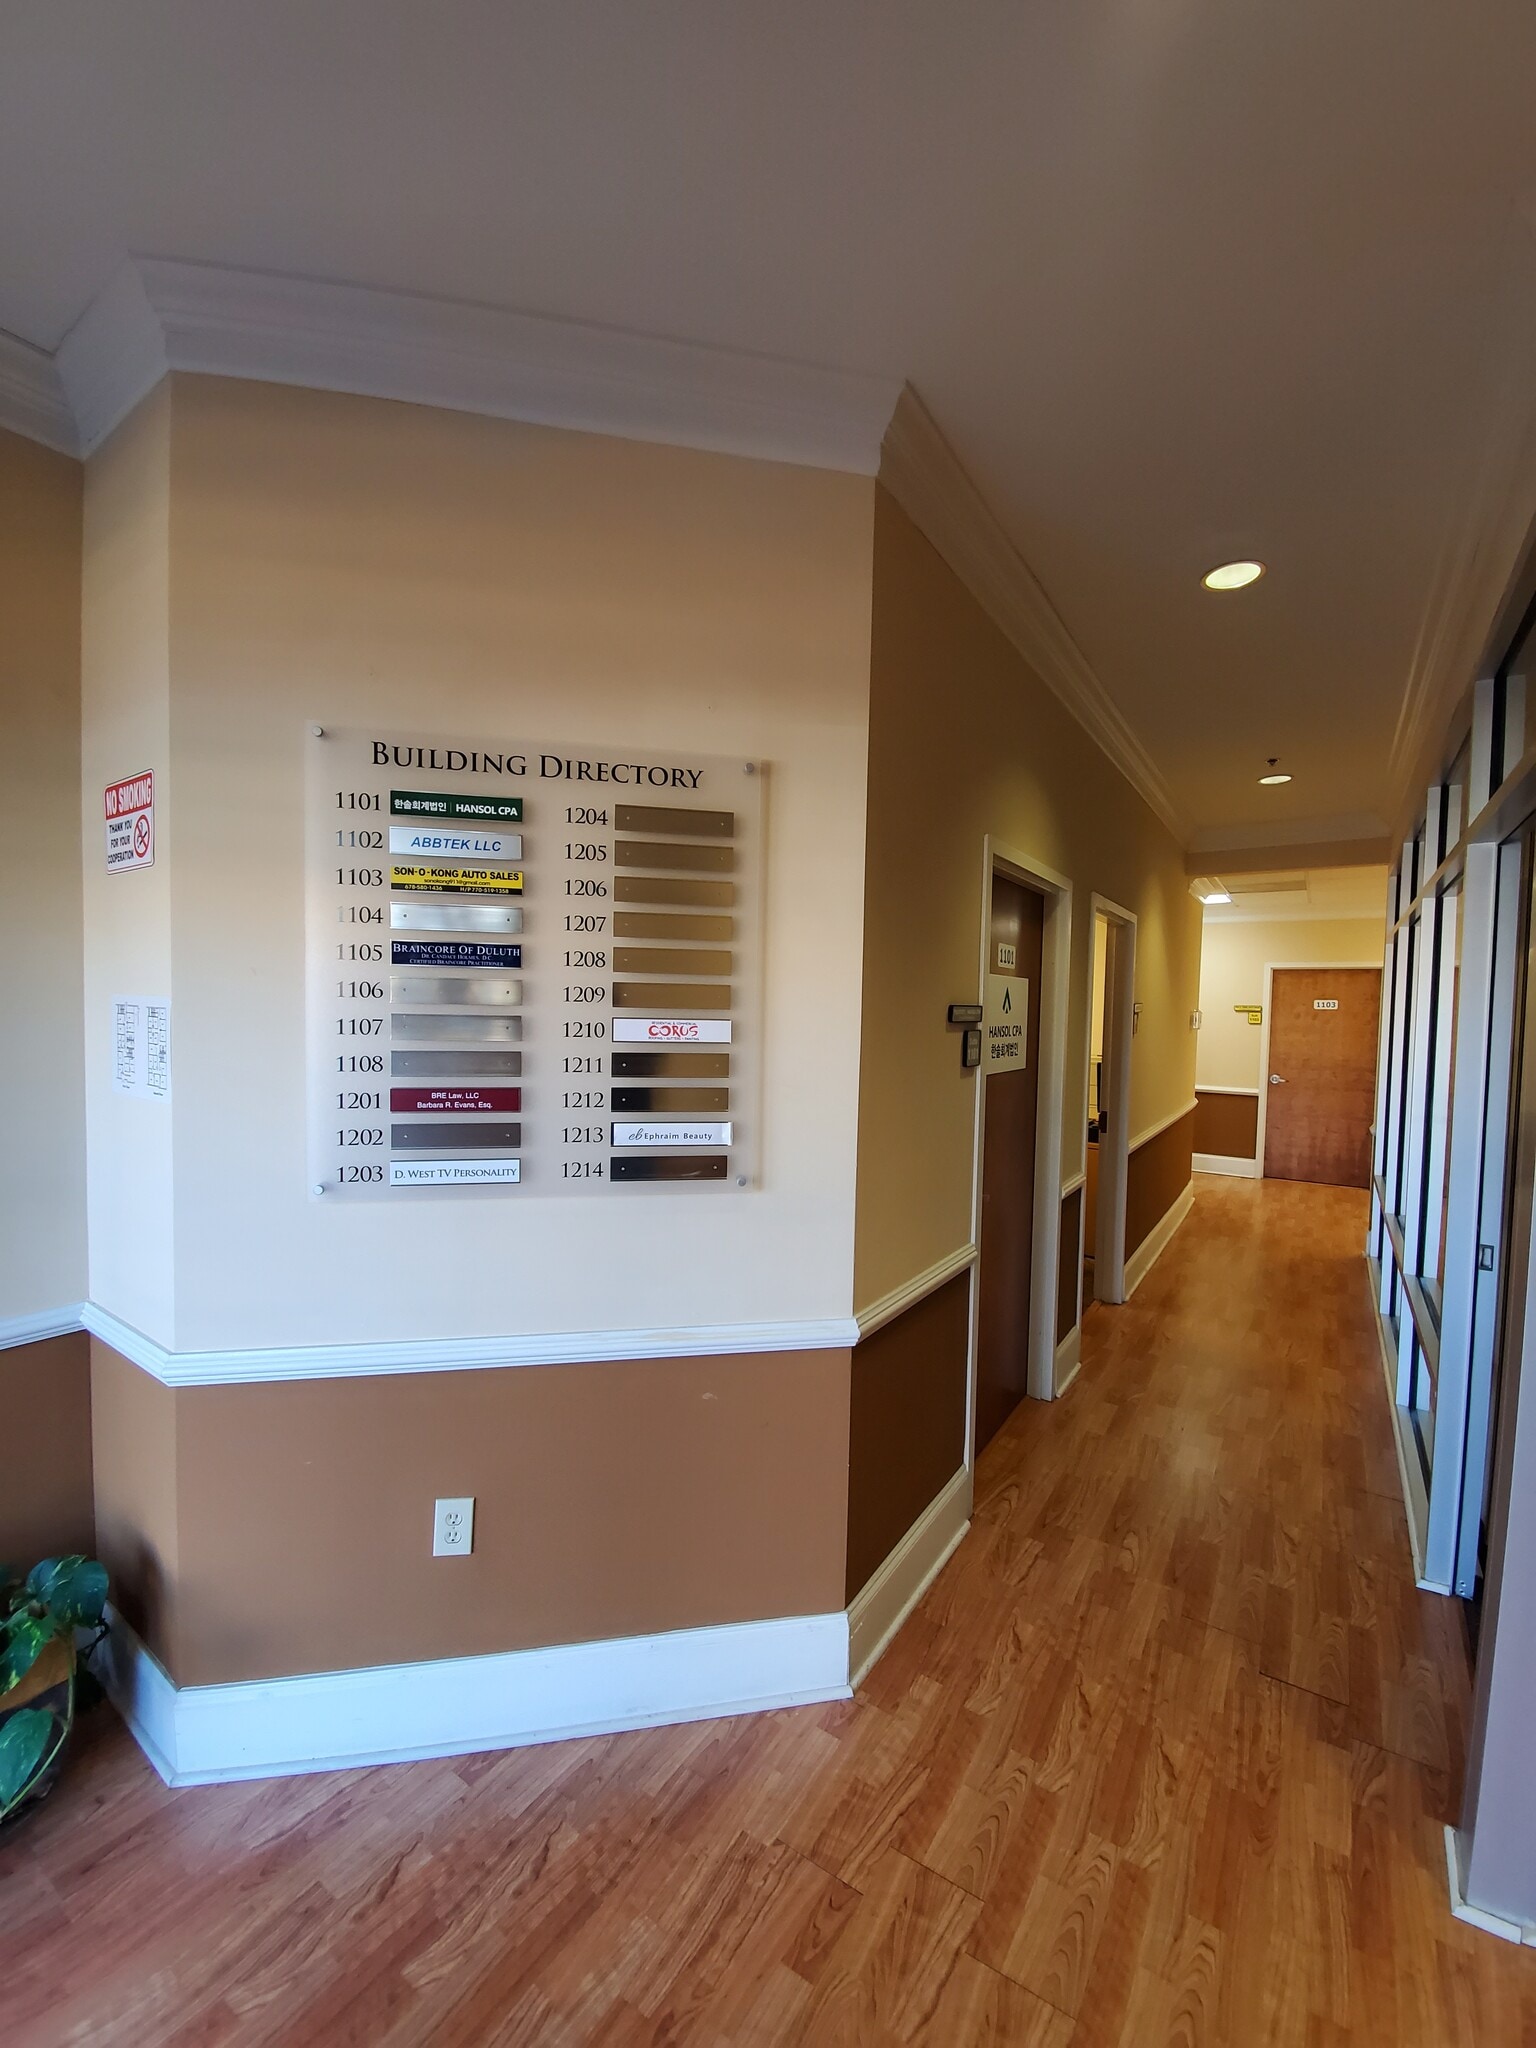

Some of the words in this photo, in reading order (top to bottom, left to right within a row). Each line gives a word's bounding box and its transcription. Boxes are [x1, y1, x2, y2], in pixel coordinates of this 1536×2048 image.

[371, 741, 528, 776] BUILDING
[539, 755, 704, 788] DIRECTORY
[106, 790, 117, 816] NO
[118, 778, 151, 812] SMOKING
[336, 792, 381, 811] 1101
[394, 799, 446, 812] 한솔회계법인
[455, 803, 496, 815] HANSOL
[498, 806, 518, 816] CPA
[564, 807, 608, 826] 1204
[109, 822, 123, 834] THANK
[120, 835, 130, 846] YOUR
[336, 830, 383, 849] 1102
[411, 837, 471, 850] ABBTEK
[474, 840, 502, 852] LLC
[108, 850, 134, 864] COOPERATION
[564, 843, 607, 861] 1205
[336, 868, 383, 887] 1103
[461, 870, 487, 879] AUTO
[490, 872, 519, 880] SALES
[564, 880, 607, 897] 1206
[337, 906, 384, 924] 1104
[564, 916, 606, 932] 1207
[337, 944, 383, 961] 1105
[393, 943, 456, 954] BRAINCORE
[459, 945, 474, 954] OF
[477, 946, 520, 956] DULUTH
[1000, 948, 1014, 965] 1101
[563, 951, 606, 968] 1208
[337, 981, 384, 998] 1106
[563, 986, 605, 1004] 1209
[336, 1018, 384, 1035] 1107
[562, 1022, 605, 1038] 1210
[648, 1025, 698, 1037] CORUS
[989, 1025, 1011, 1038] HANSOL
[1012, 1025, 1022, 1037] CPA
[336, 1056, 384, 1073] 1108
[562, 1057, 603, 1073] 1211
[336, 1092, 380, 1109] 1201
[562, 1092, 604, 1108] 1212
[336, 1129, 384, 1146] 1202
[561, 1127, 603, 1143] 1213
[644, 1132, 679, 1141] Ephraim
[684, 1132, 712, 1141] Beauty
[336, 1166, 383, 1183] 1203
[394, 1170, 406, 1179] D.
[408, 1170, 435, 1178] WEST
[437, 1169, 452, 1178] TV
[454, 1168, 517, 1177] PERSONALITY
[561, 1162, 603, 1178] 1214
